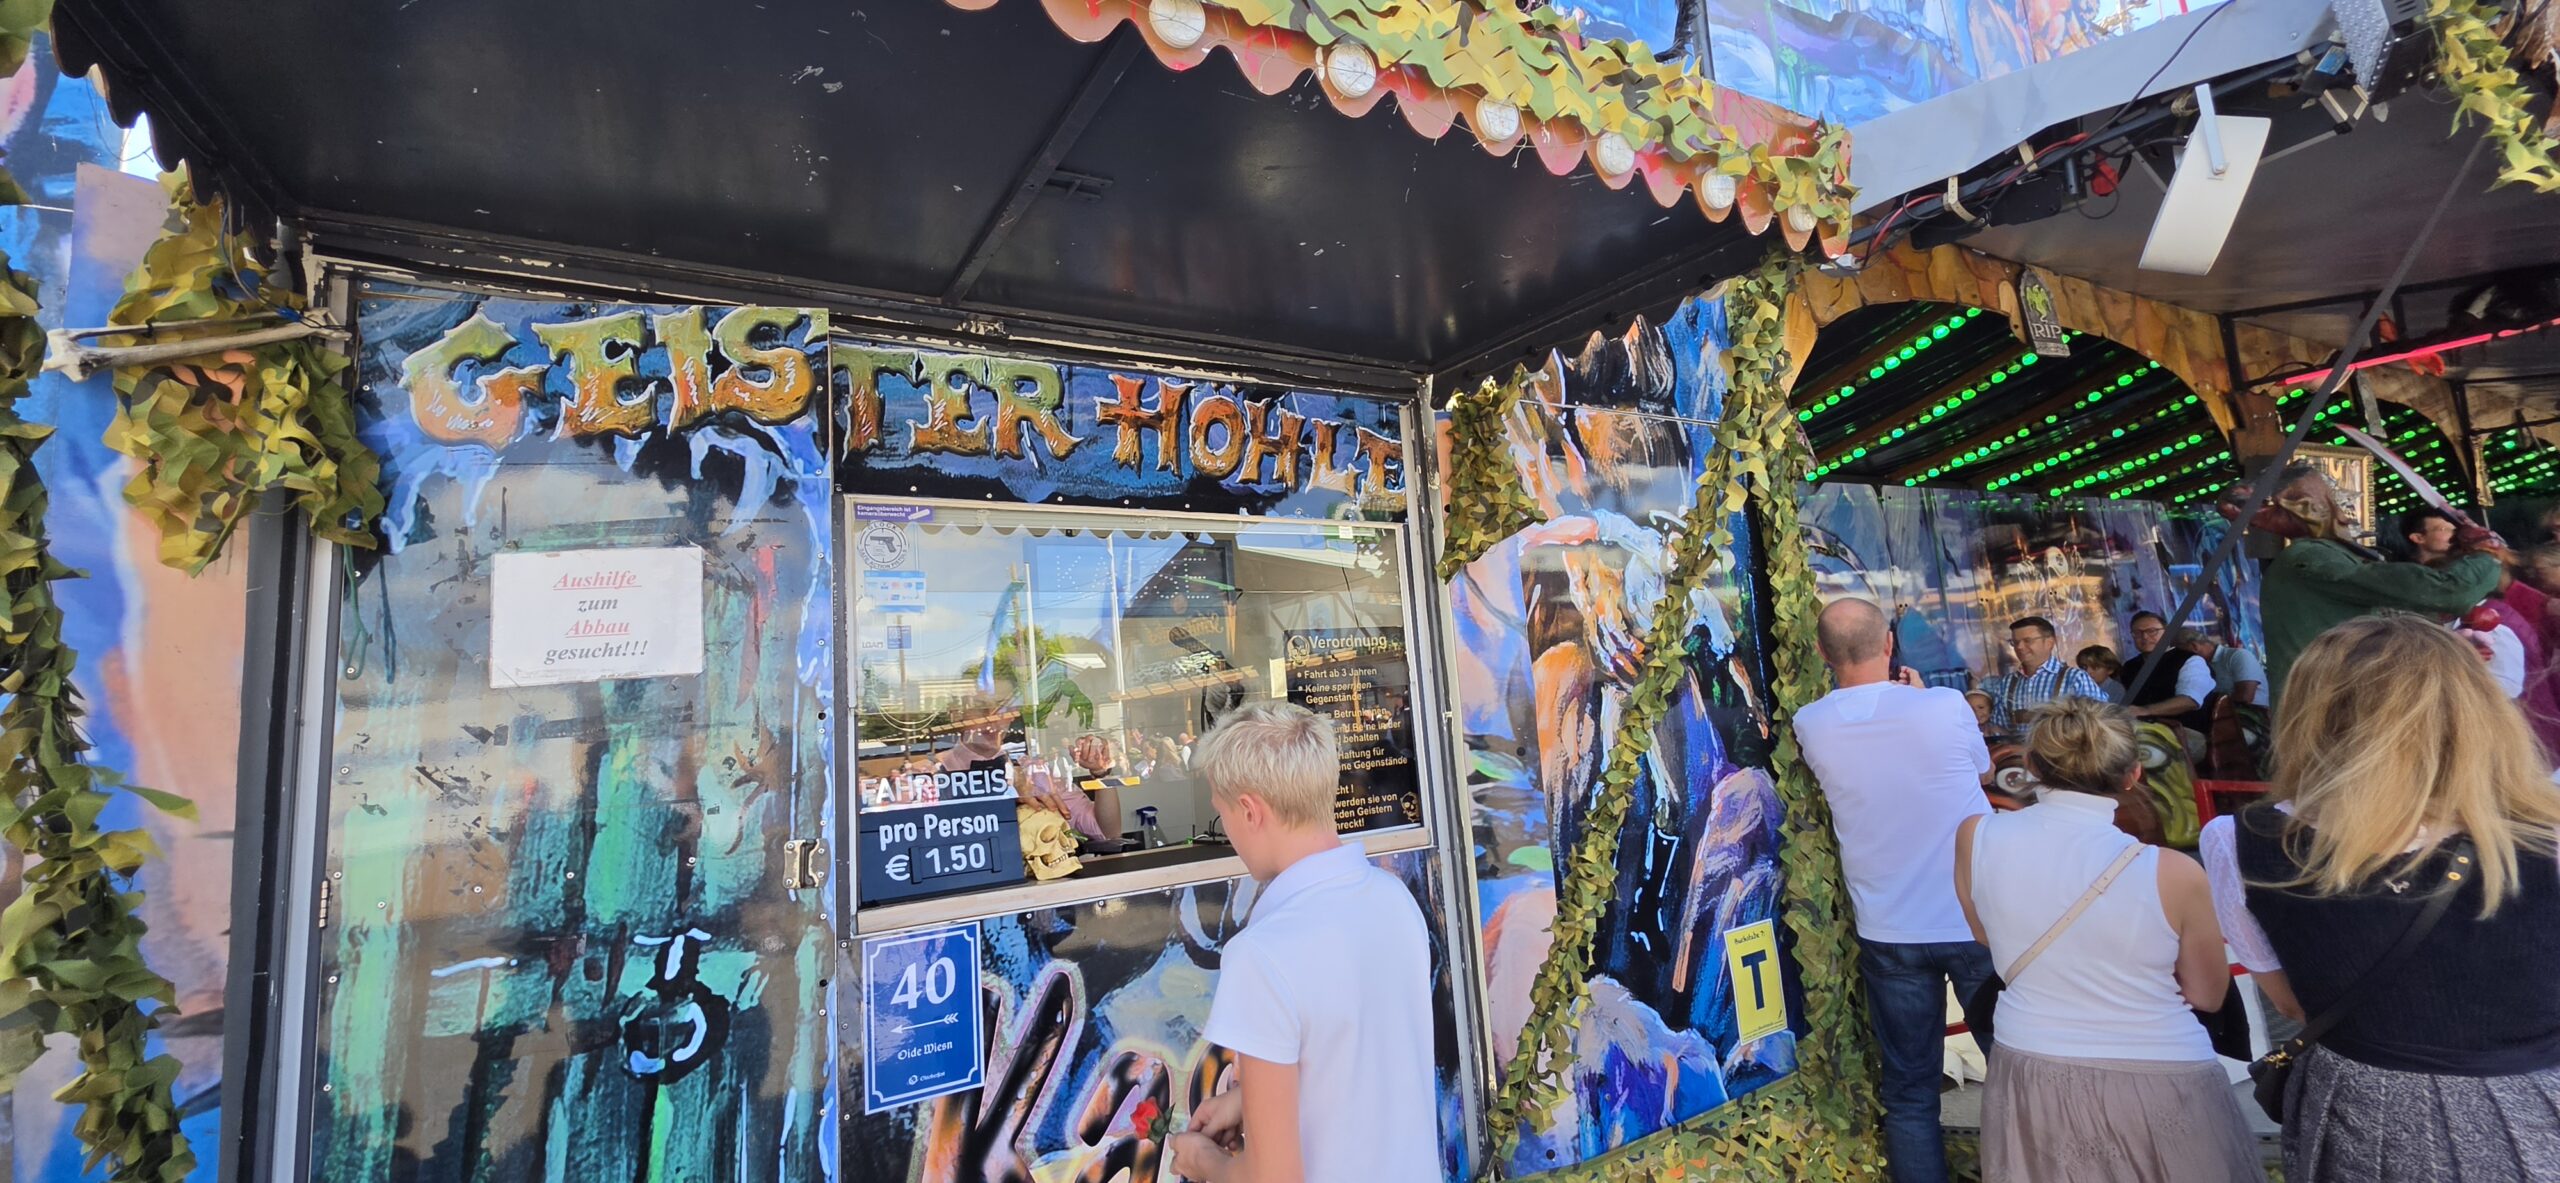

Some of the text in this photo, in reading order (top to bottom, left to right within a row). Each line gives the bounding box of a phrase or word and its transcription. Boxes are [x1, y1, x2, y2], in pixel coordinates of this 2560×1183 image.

[2031, 323, 2062, 339] RIP
[401, 306, 1084, 463] GEISTER
[857, 505, 903, 513] Eingangsbereich
[868, 522, 897, 531] GLOCK
[552, 570, 638, 590] Aushilfe
[577, 599, 618, 612] zum
[564, 618, 630, 637] Abbau
[1308, 634, 1388, 649] Verordnung
[543, 640, 648, 665] gesucht!!!
[1304, 667, 1378, 679] Fahrt ab 3 Jahren
[1305, 681, 1372, 693] Keine sperrigen
[1306, 692, 1363, 705] Gegenstände
[1343, 733, 1380, 743] behalten
[1338, 747, 1385, 760] Haftung für
[1353, 756, 1408, 771] Gegenstände
[861, 768, 1009, 805] FAHRPREIS
[1335, 793, 1398, 808] werden sie von
[1356, 805, 1393, 817] Geistern
[879, 813, 1000, 851] pro Person
[885, 842, 987, 881] € 1.50
[890, 956, 956, 1010] 40
[1741, 949, 1768, 1011] T
[897, 1041, 953, 1060] Oide Wiesn
